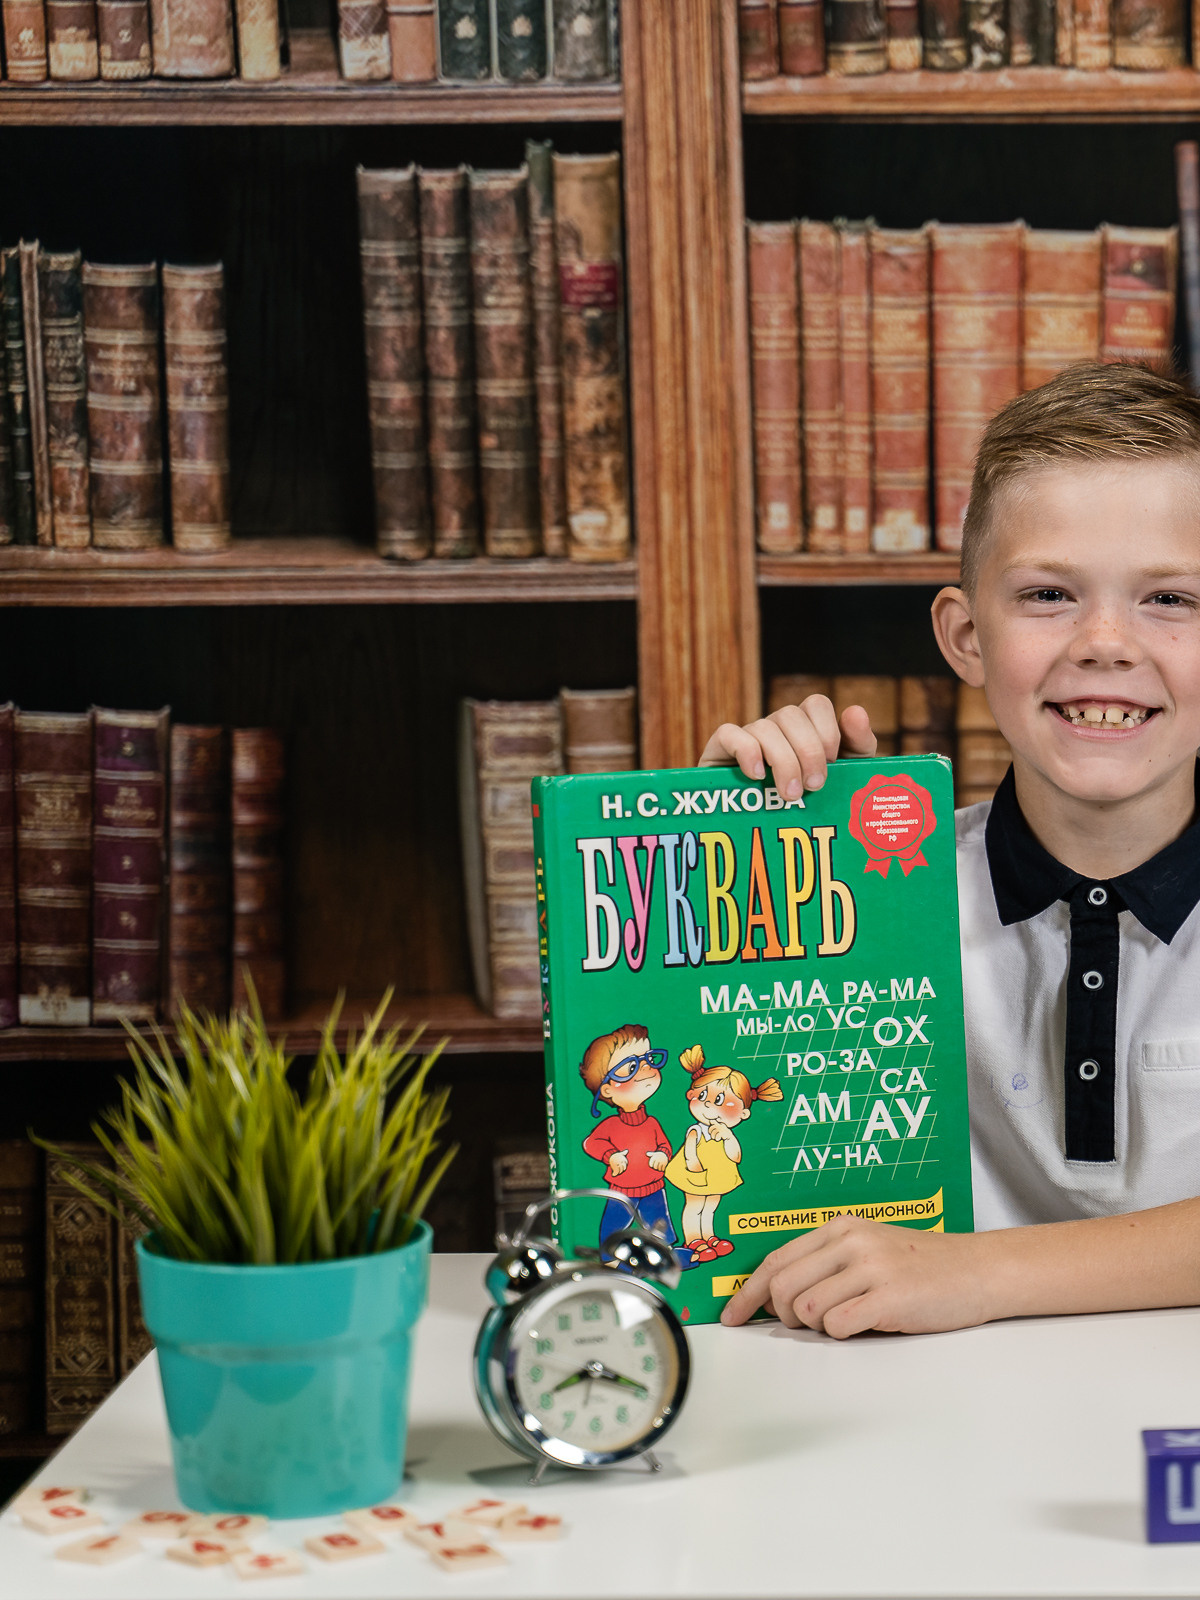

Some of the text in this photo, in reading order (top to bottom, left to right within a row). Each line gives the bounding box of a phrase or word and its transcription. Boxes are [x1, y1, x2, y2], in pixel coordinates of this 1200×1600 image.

[602, 794, 632, 818] Н.
[636, 792, 667, 817] С.
[872, 803, 910, 811] Министерством
[870, 818, 918, 828] профессионального
[876, 827, 909, 835] образования
[577, 825, 857, 972] БУКВАРЬ
[700, 976, 936, 1013] МА-МА РА-МА
[736, 1005, 930, 1047] МЫ-ЛО УС ОХ
[787, 1048, 876, 1075] РО-ЗА
[880, 1067, 928, 1093] СА
[788, 1091, 931, 1141] АМ АУ
[793, 1144, 883, 1171] ЛУ-НА
[737, 1212, 817, 1229] СОЧЕТАНИЕ
